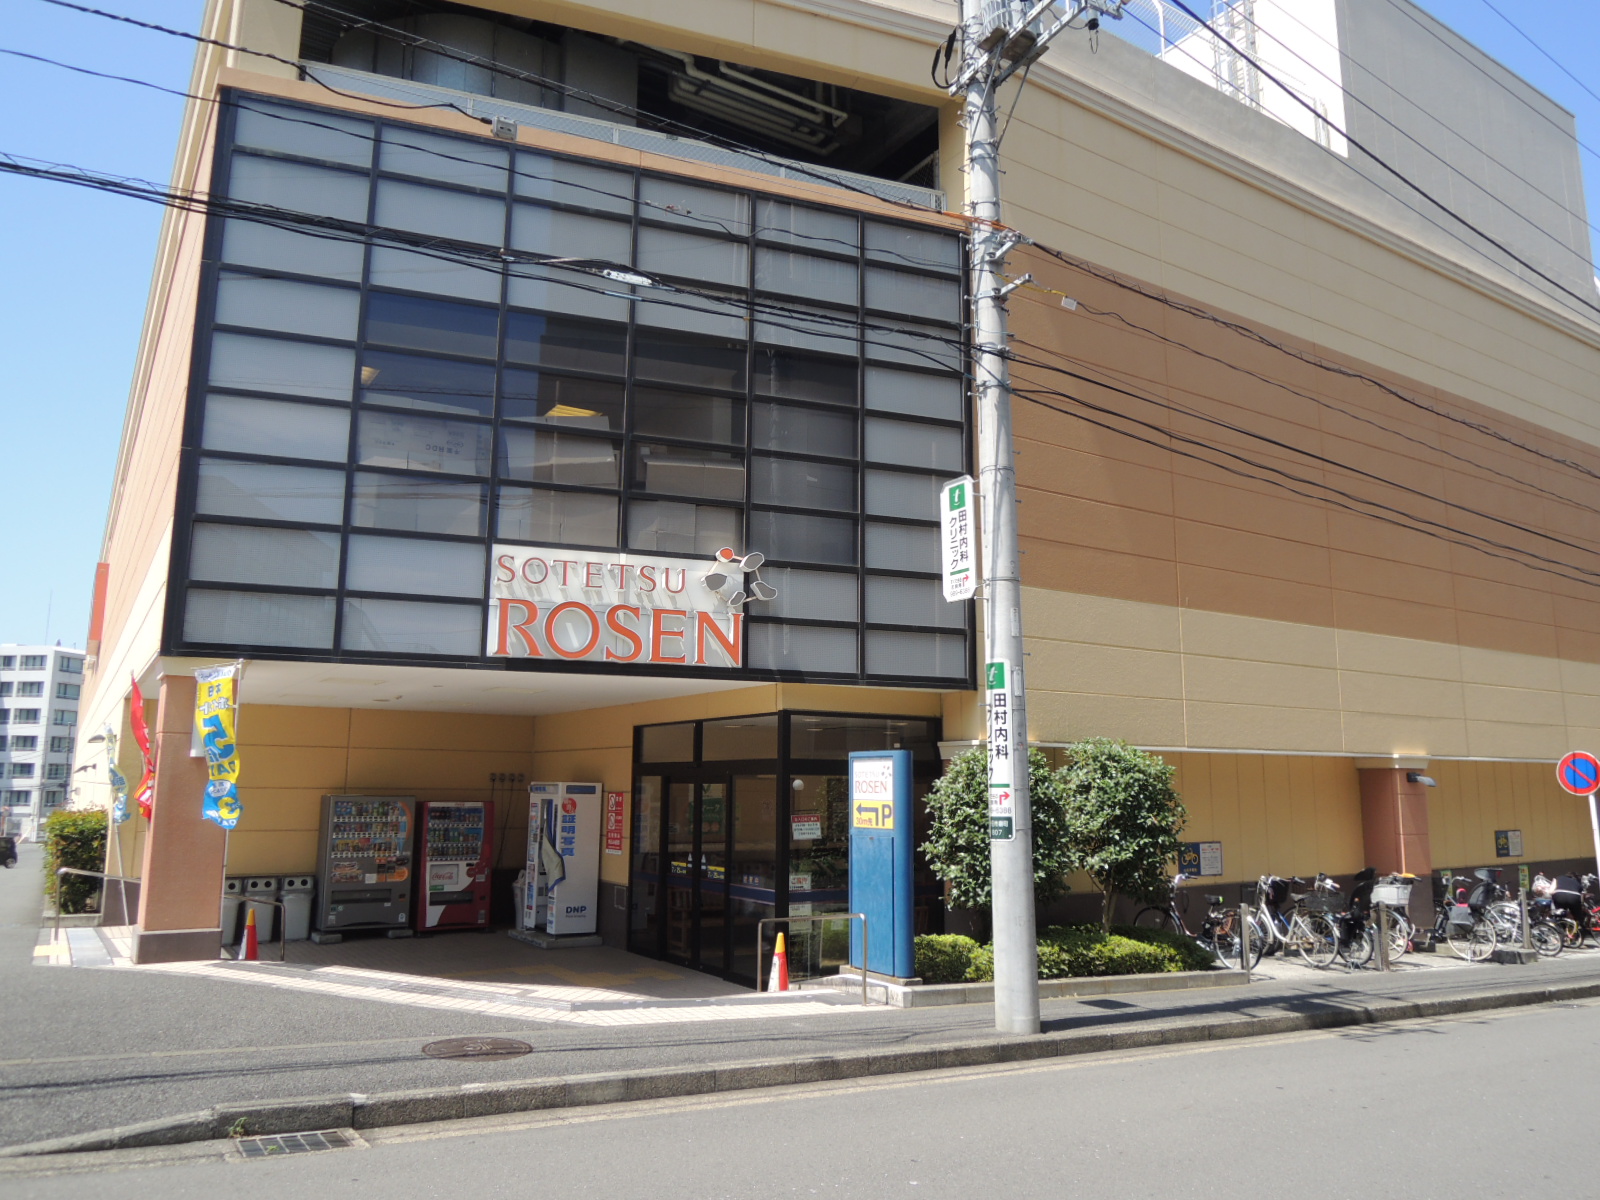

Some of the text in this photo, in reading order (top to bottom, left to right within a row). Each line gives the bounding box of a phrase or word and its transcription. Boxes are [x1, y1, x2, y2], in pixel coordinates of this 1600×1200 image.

[949, 516, 959, 570] クリニック
[958, 509, 968, 561] 田村内科
[494, 554, 687, 594] SOTETSU
[493, 598, 744, 666] ROSEN
[993, 693, 1009, 760] 田村内科
[855, 780, 888, 794] ROSEN
[881, 804, 892, 827] P
[565, 905, 587, 914] DNP
